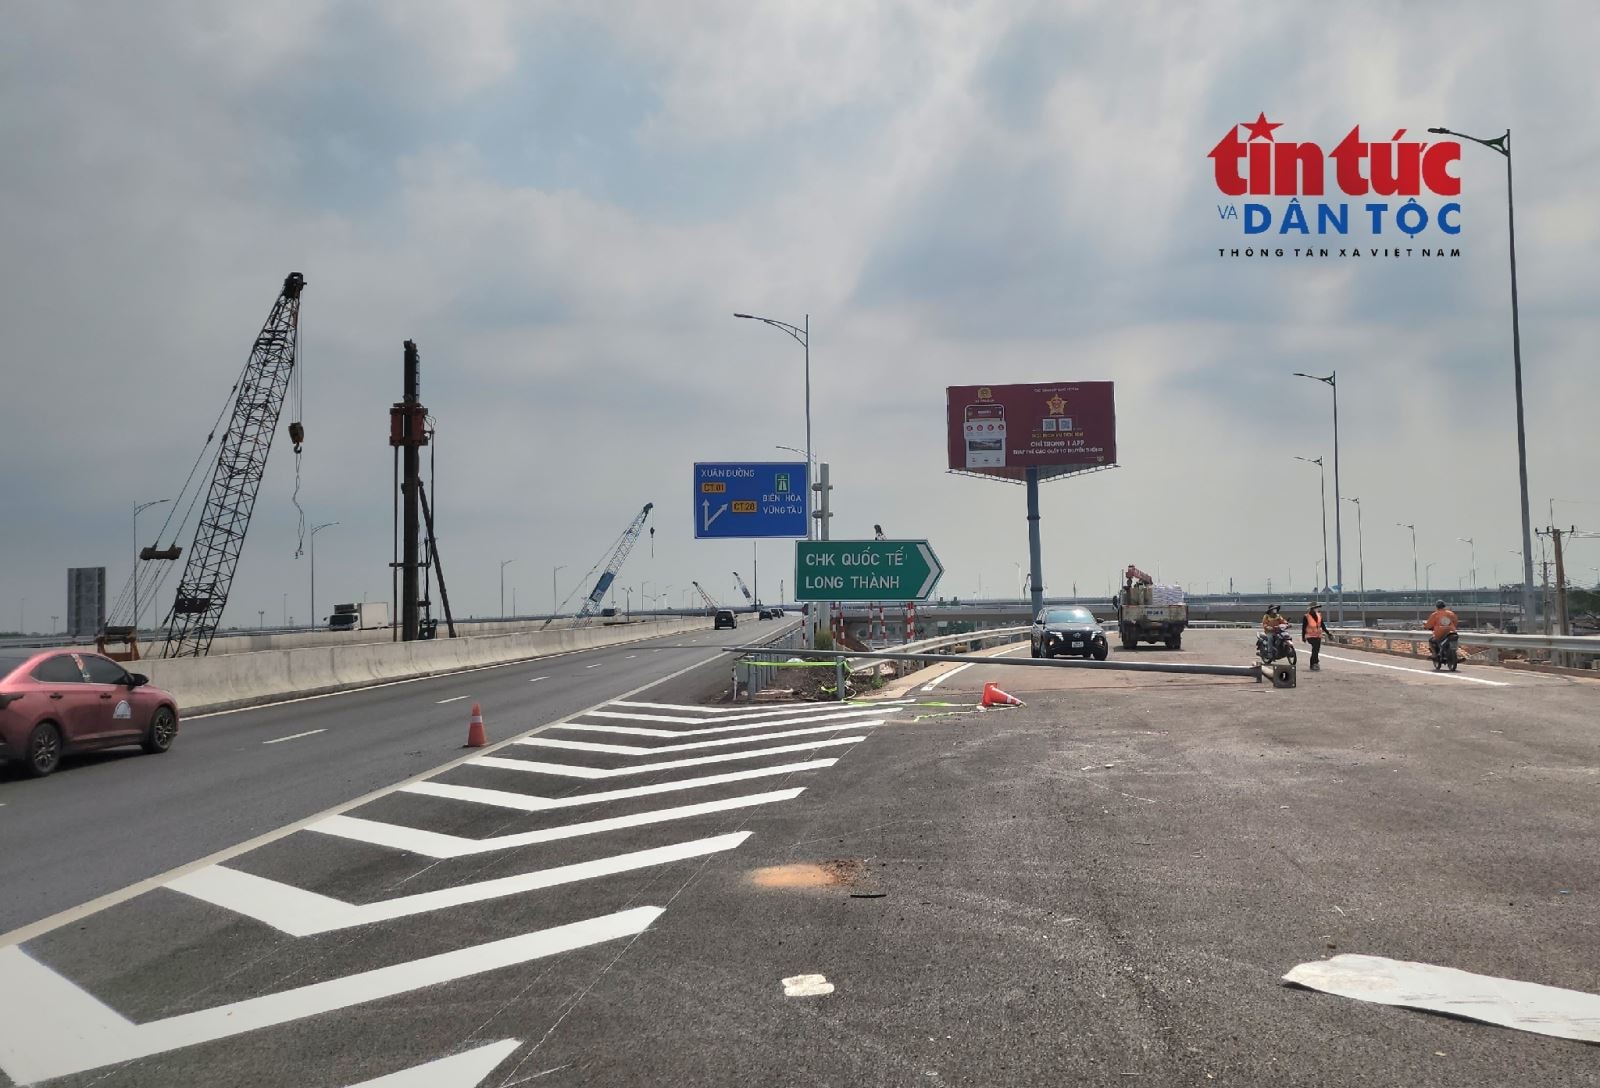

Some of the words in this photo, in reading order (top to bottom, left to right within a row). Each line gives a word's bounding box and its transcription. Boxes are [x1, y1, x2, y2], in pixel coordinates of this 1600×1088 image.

[701, 468, 725, 478] XUÂN
[805, 553, 835, 566] CHK
[841, 546, 880, 567] QUỐC
[885, 546, 904, 566] TẾ
[805, 576, 844, 589] LONG
[850, 572, 899, 589] THÀNH
